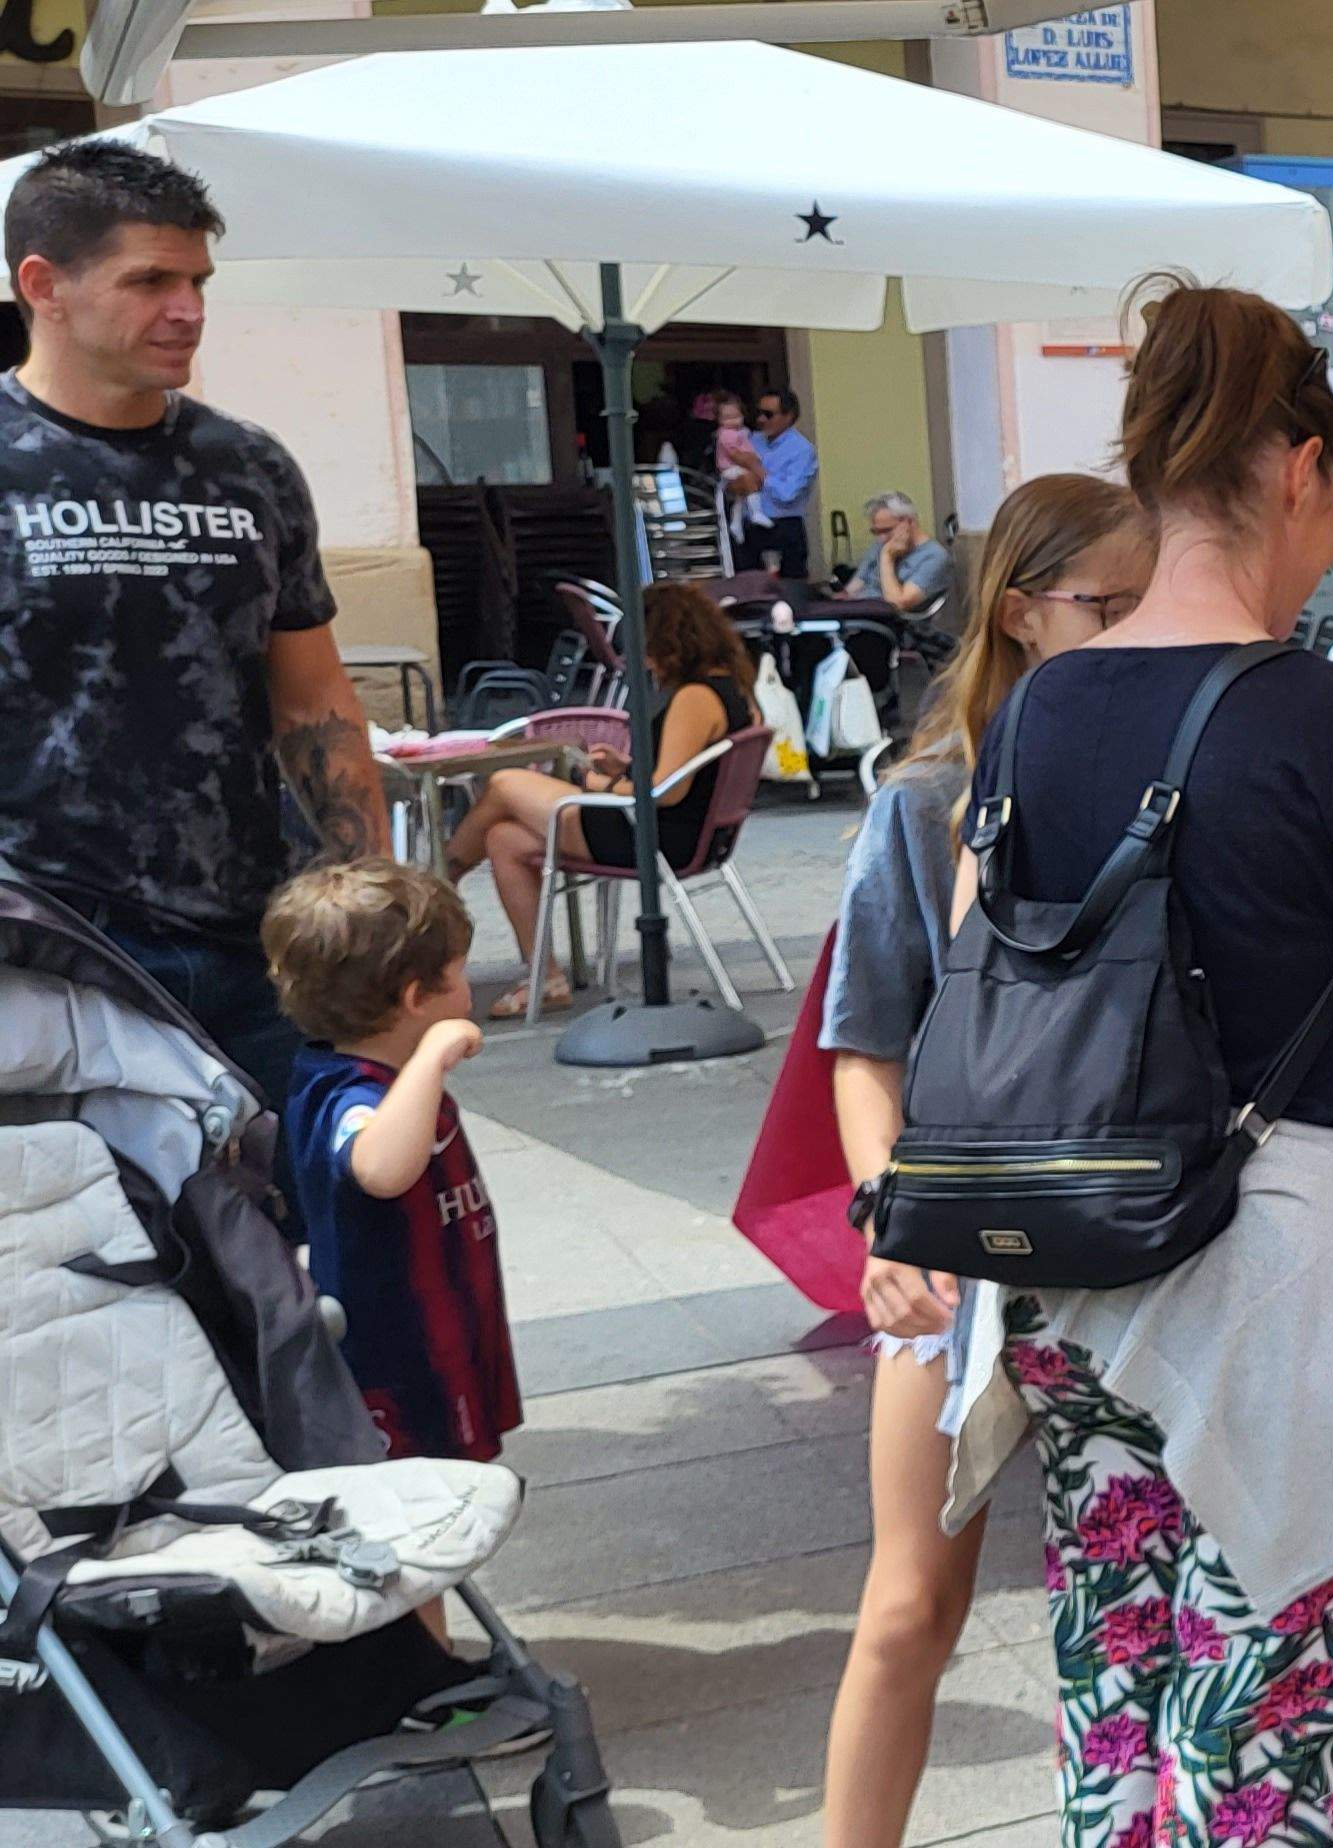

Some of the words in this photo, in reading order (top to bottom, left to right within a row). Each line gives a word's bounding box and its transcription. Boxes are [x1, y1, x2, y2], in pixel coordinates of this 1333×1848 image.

[1067, 28, 1113, 49] LUIS
[25, 537, 97, 551] SOUTHERN
[100, 536, 167, 550] CALIFORNIA
[28, 550, 86, 564] QUALITY
[87, 549, 129, 562] GOODS
[200, 554, 213, 565] IN
[214, 553, 239, 566] USA
